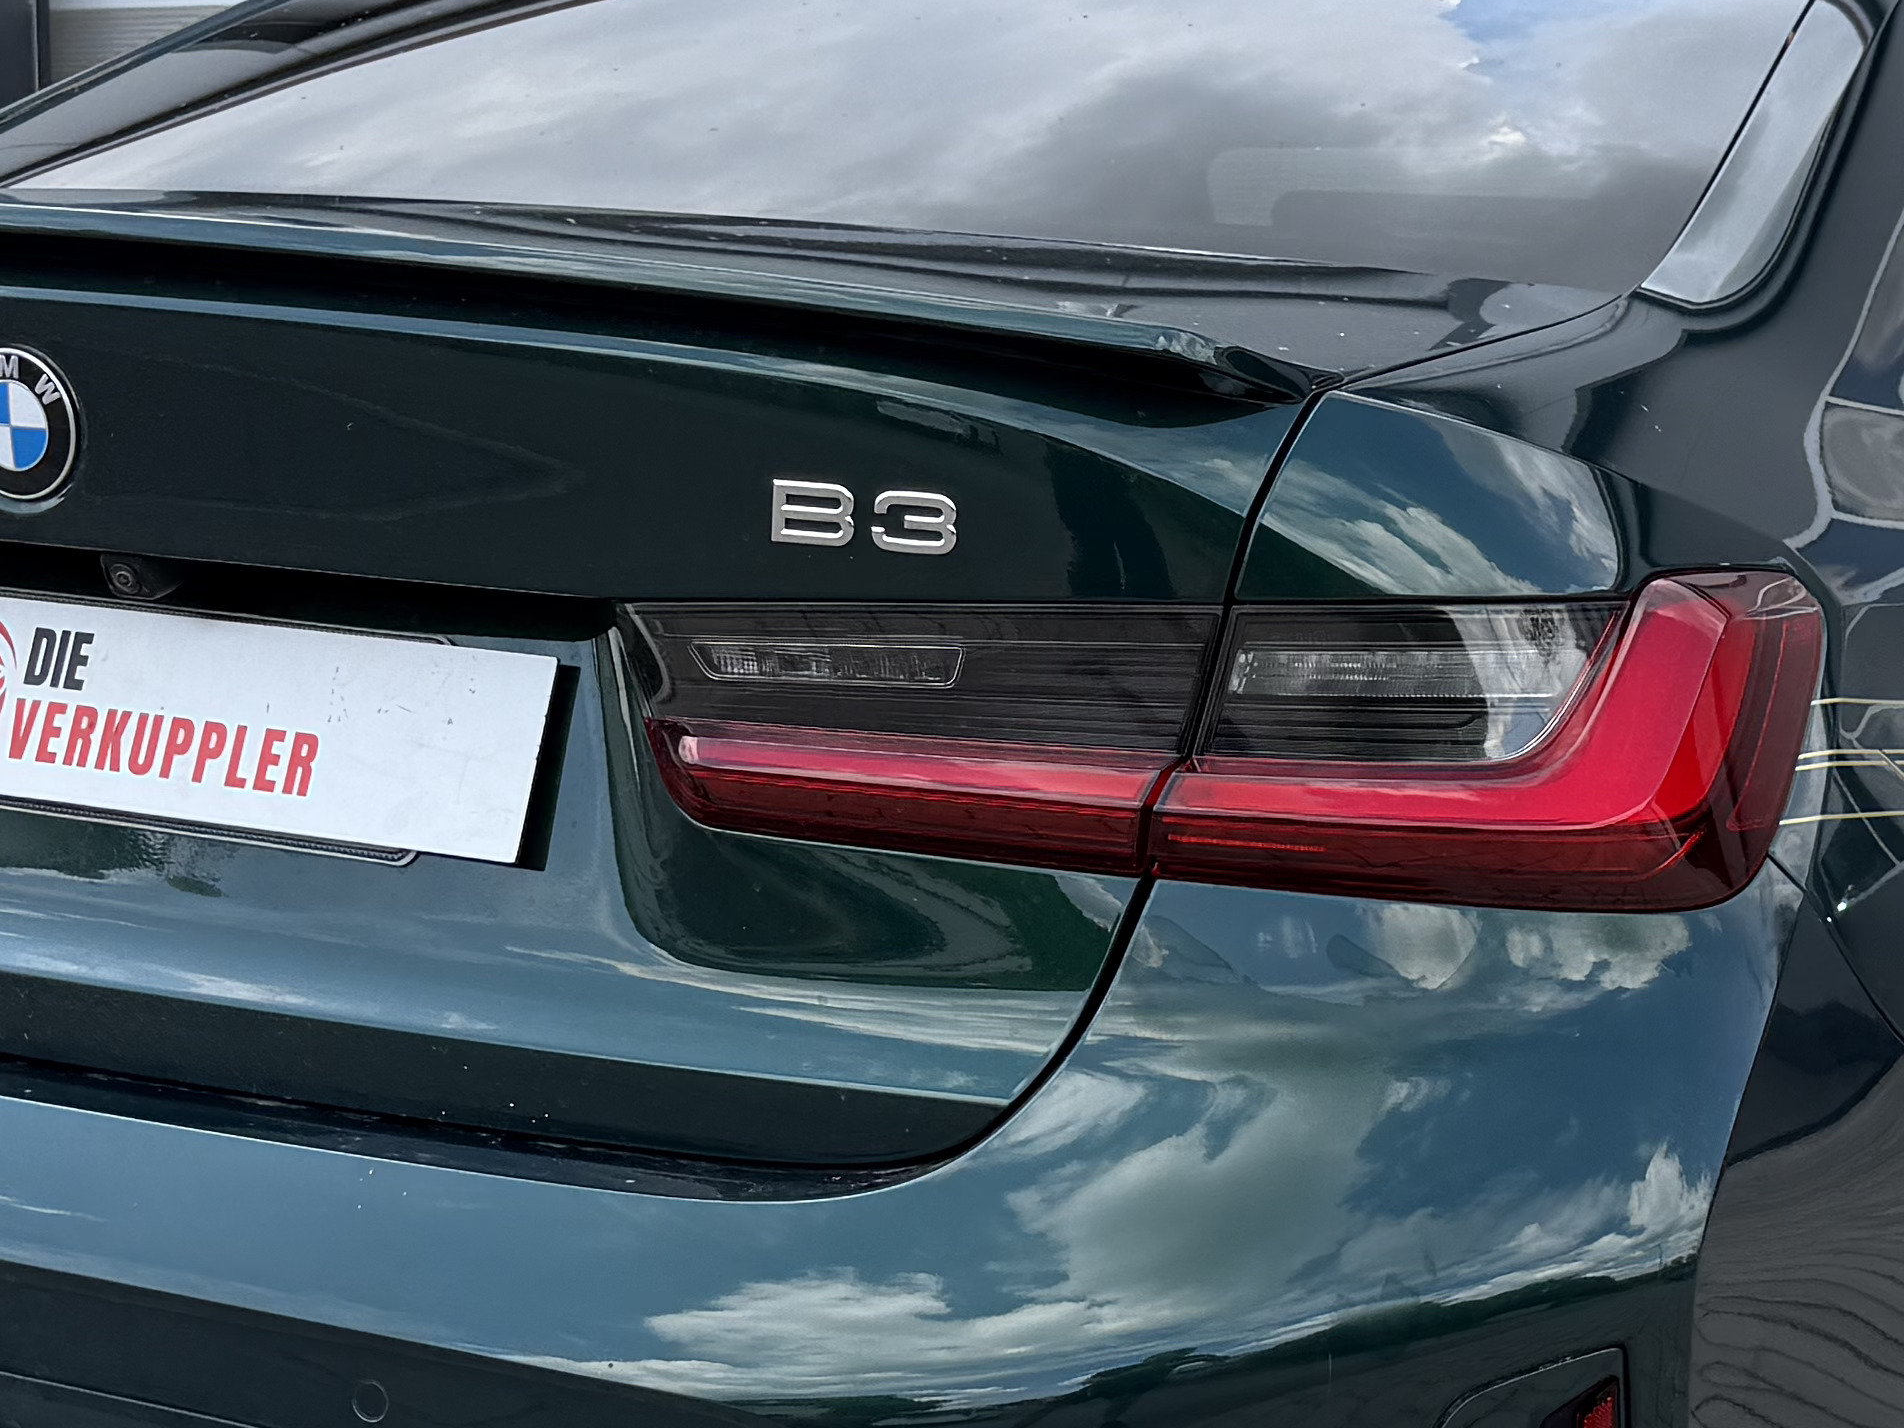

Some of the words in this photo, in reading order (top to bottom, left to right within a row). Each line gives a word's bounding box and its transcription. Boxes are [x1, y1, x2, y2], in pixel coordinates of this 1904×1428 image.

[771, 478, 957, 555] B3
[24, 627, 95, 692] DIE
[8, 698, 321, 798] VERKUPPLER
